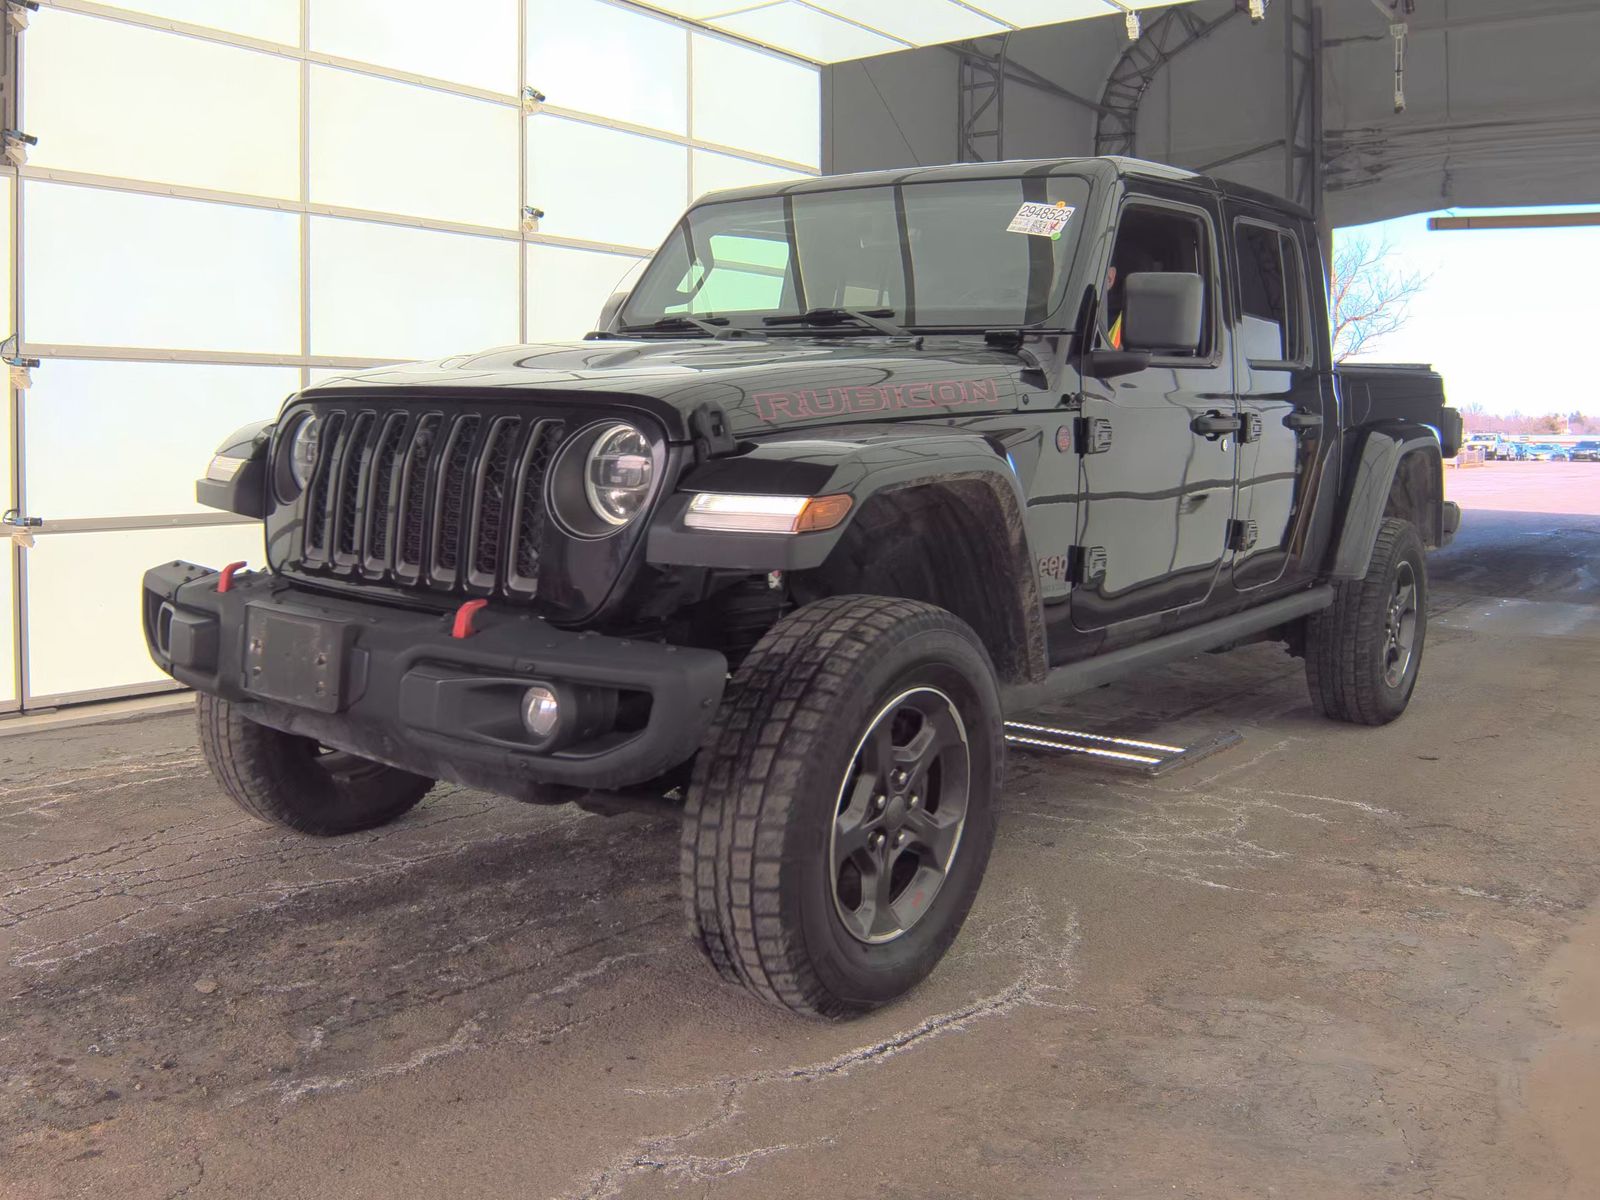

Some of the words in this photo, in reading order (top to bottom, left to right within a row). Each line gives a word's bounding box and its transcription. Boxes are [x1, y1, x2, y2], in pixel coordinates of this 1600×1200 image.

[1018, 205, 1072, 222] 2948523
[752, 379, 999, 420] RUBICON
[1038, 555, 1068, 580] eep
